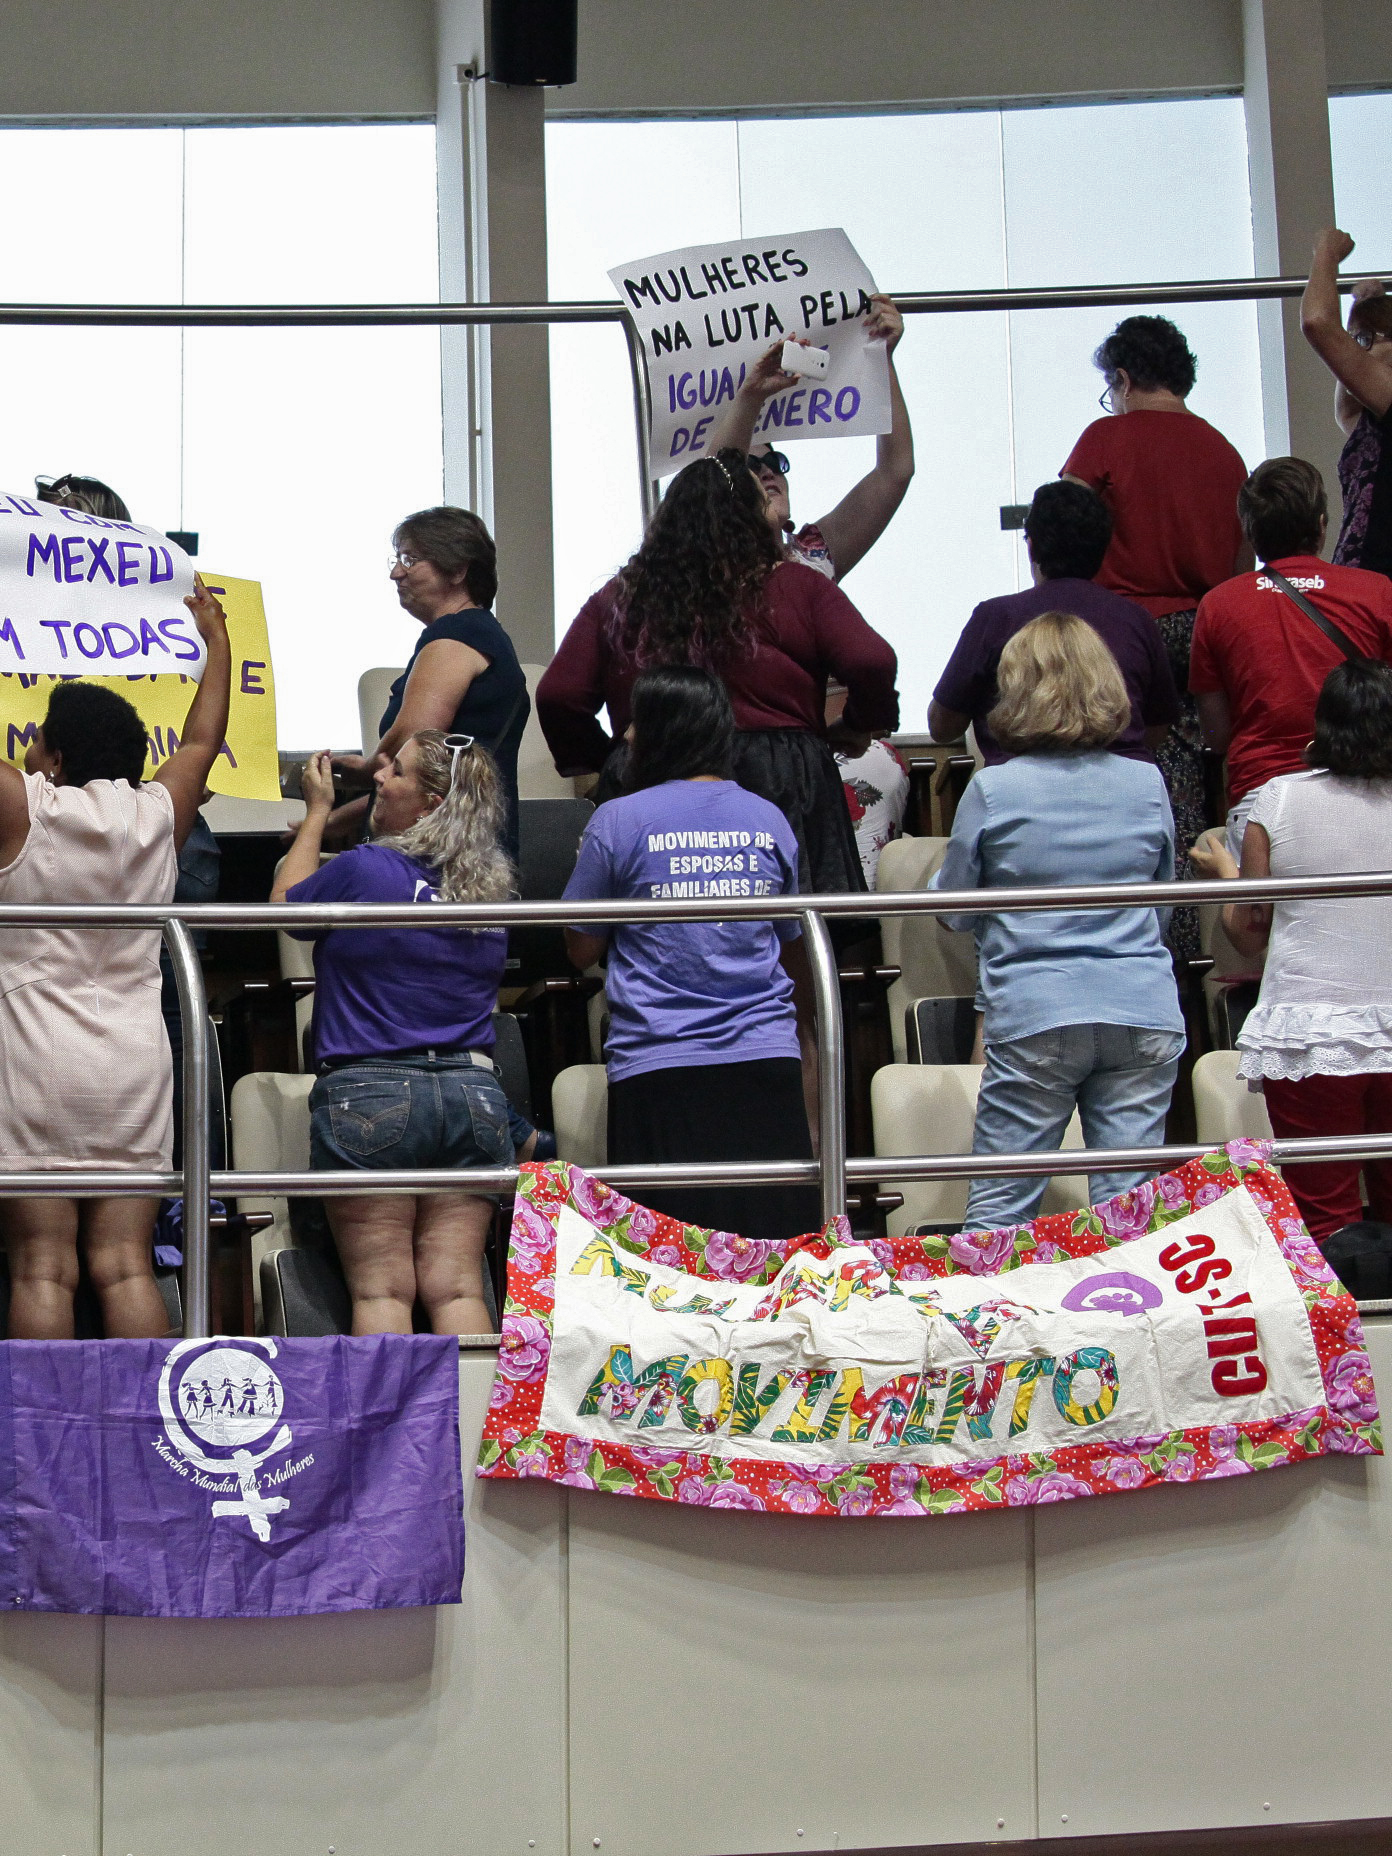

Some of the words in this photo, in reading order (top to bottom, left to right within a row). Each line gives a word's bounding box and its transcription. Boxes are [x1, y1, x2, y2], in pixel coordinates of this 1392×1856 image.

[623, 249, 809, 309] MULHERES
[651, 320, 692, 357] NA
[704, 302, 784, 348] LUTA
[800, 288, 872, 329] PELA
[669, 416, 714, 457] DE
[754, 386, 861, 433] NERO
[60, 508, 147, 535] COM
[27, 533, 174, 587] MEXEU
[39, 617, 201, 662] TODAS
[648, 831, 751, 852] MOVIMENTO
[754, 831, 774, 850] DE
[670, 854, 744, 874] ESPOSAS
[749, 854, 759, 872] E
[650, 878, 750, 898] FAMILIARES
[754, 879, 772, 896] DE
[577, 1344, 1120, 1448] MOVIMENTO
[151, 1435, 189, 1477] Marcha
[190, 1468, 242, 1493] Mundial
[263, 1453, 315, 1487] Mulheres
